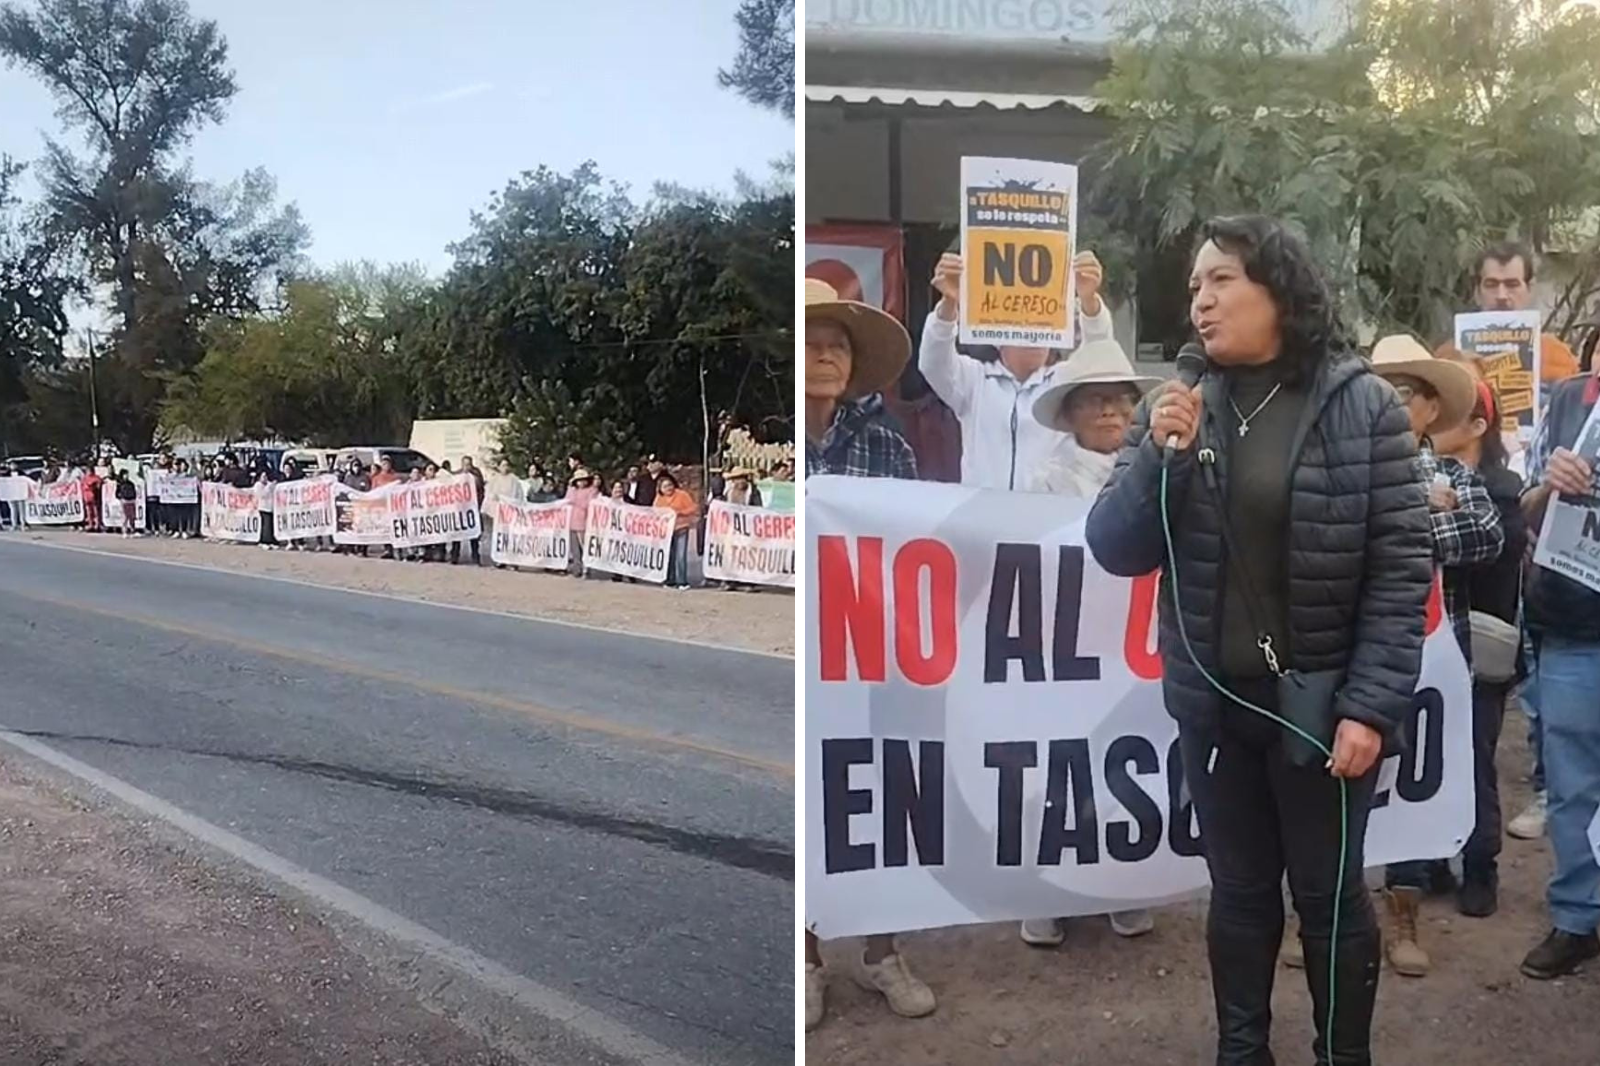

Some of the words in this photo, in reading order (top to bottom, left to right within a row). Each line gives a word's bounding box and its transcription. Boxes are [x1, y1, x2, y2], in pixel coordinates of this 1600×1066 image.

[976, 191, 1062, 210] TASQUILLO
[983, 242, 1053, 288] NO
[981, 292, 999, 314] AL
[1002, 295, 1058, 316] CERESO
[972, 330, 1009, 339] somos
[390, 491, 407, 512] NO
[410, 489, 423, 509] AL
[425, 482, 471, 507] CERESO
[291, 508, 332, 530] TASQUILL
[393, 519, 408, 538] EN
[413, 509, 475, 536] TASQUILLO
[499, 505, 514, 525] NO
[516, 506, 528, 527] AL
[593, 506, 609, 530] NO
[612, 508, 623, 531] AL
[625, 512, 669, 540] CERESO
[711, 510, 729, 535] NO
[733, 512, 750, 537] AL
[754, 514, 795, 539] CERE
[497, 532, 509, 552] EN
[512, 533, 566, 559] TASQUILLO
[588, 535, 602, 558] EN
[608, 538, 664, 571] TASQUILLO
[708, 543, 725, 568] EN
[731, 545, 795, 575] TASQUILL
[818, 535, 958, 686] NO
[983, 542, 1101, 683] AL
[822, 737, 944, 875] EN
